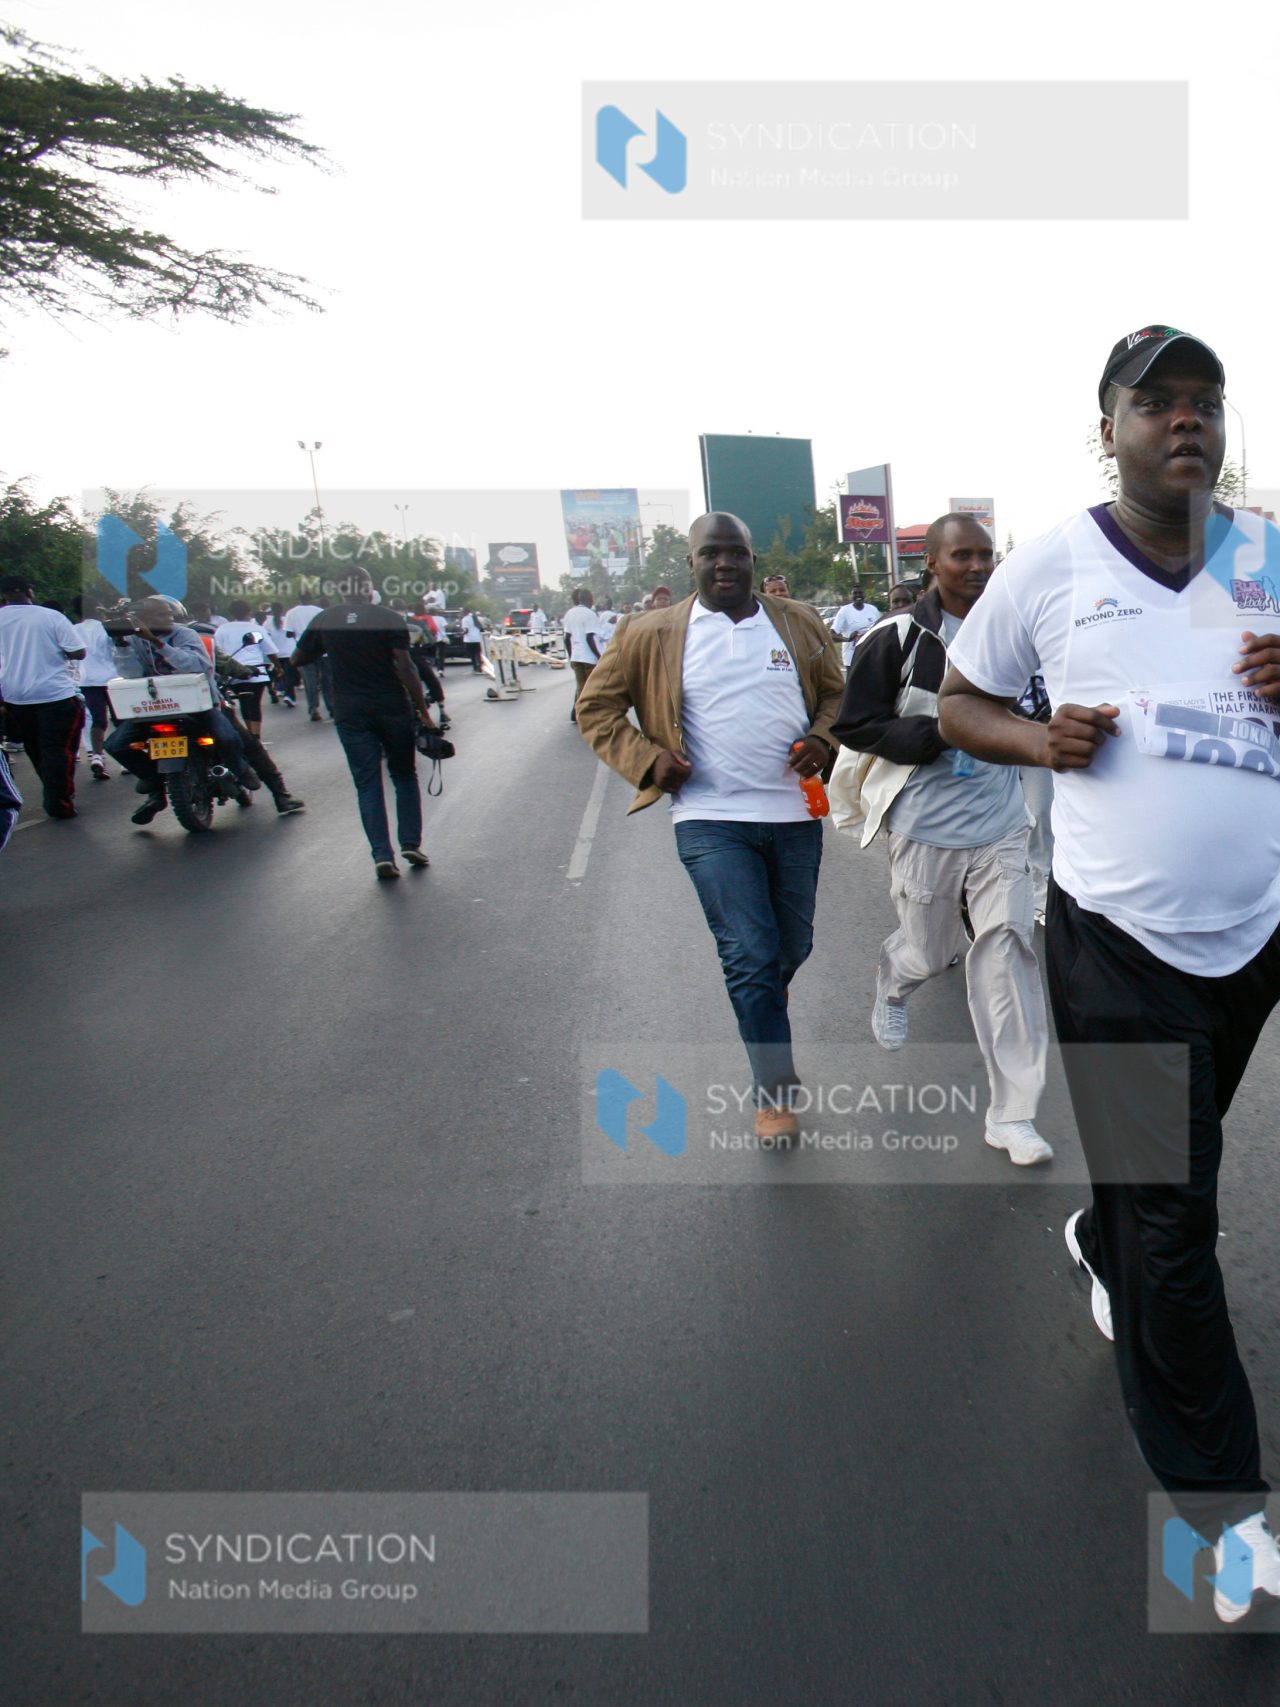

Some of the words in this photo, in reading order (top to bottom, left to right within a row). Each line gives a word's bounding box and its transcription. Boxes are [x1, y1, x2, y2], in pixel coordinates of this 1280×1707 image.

[1075, 611, 1114, 627] BEYOND
[1117, 608, 1143, 616] ZERO
[1213, 691, 1234, 702] THE
[143, 703, 180, 712] YAMAHA
[1216, 703, 1245, 713] HALF
